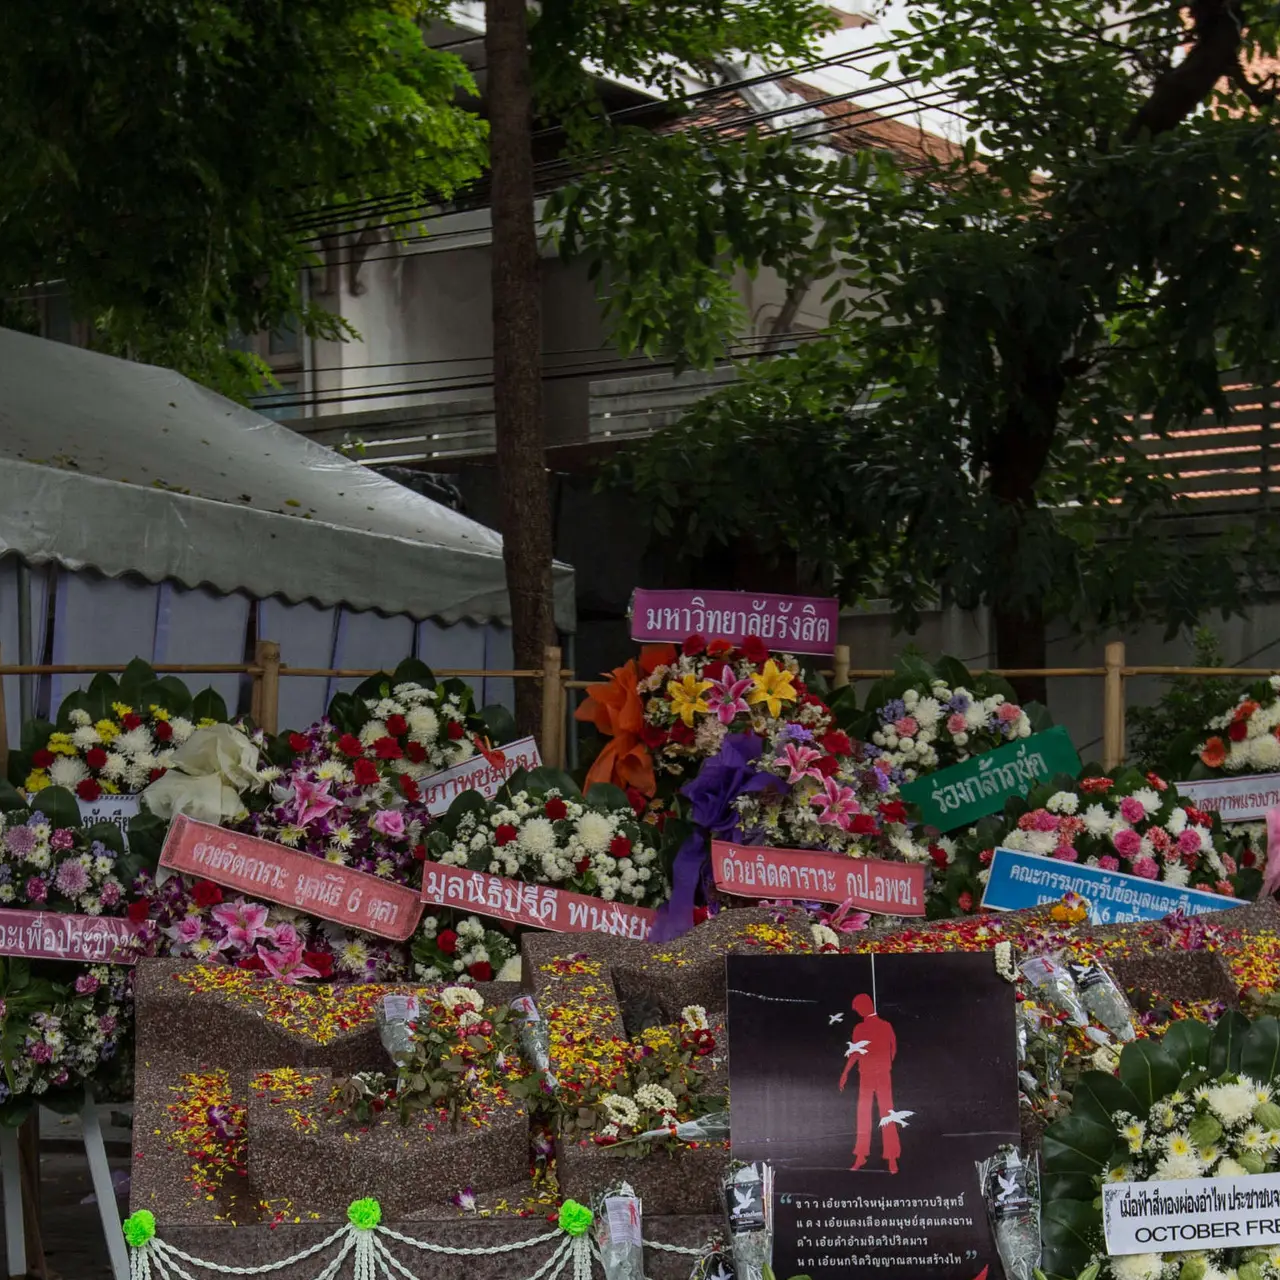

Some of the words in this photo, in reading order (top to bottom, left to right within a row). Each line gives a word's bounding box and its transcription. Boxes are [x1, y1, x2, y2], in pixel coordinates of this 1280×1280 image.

[646, 596, 830, 643] มหาวิทยาลัยรังสิต
[427, 871, 558, 922] มูลนิธิปรีดี
[568, 901, 652, 941] พนมย
[846, 863, 918, 906] กป.อพช.
[346, 886, 363, 913] 6
[367, 899, 400, 930] ตุลา
[1101, 905, 1111, 922] 6
[1120, 1183, 1227, 1218] เมื่อฟ้าสีทองผ่องอำไพ
[1134, 1220, 1241, 1243] OCTOBER
